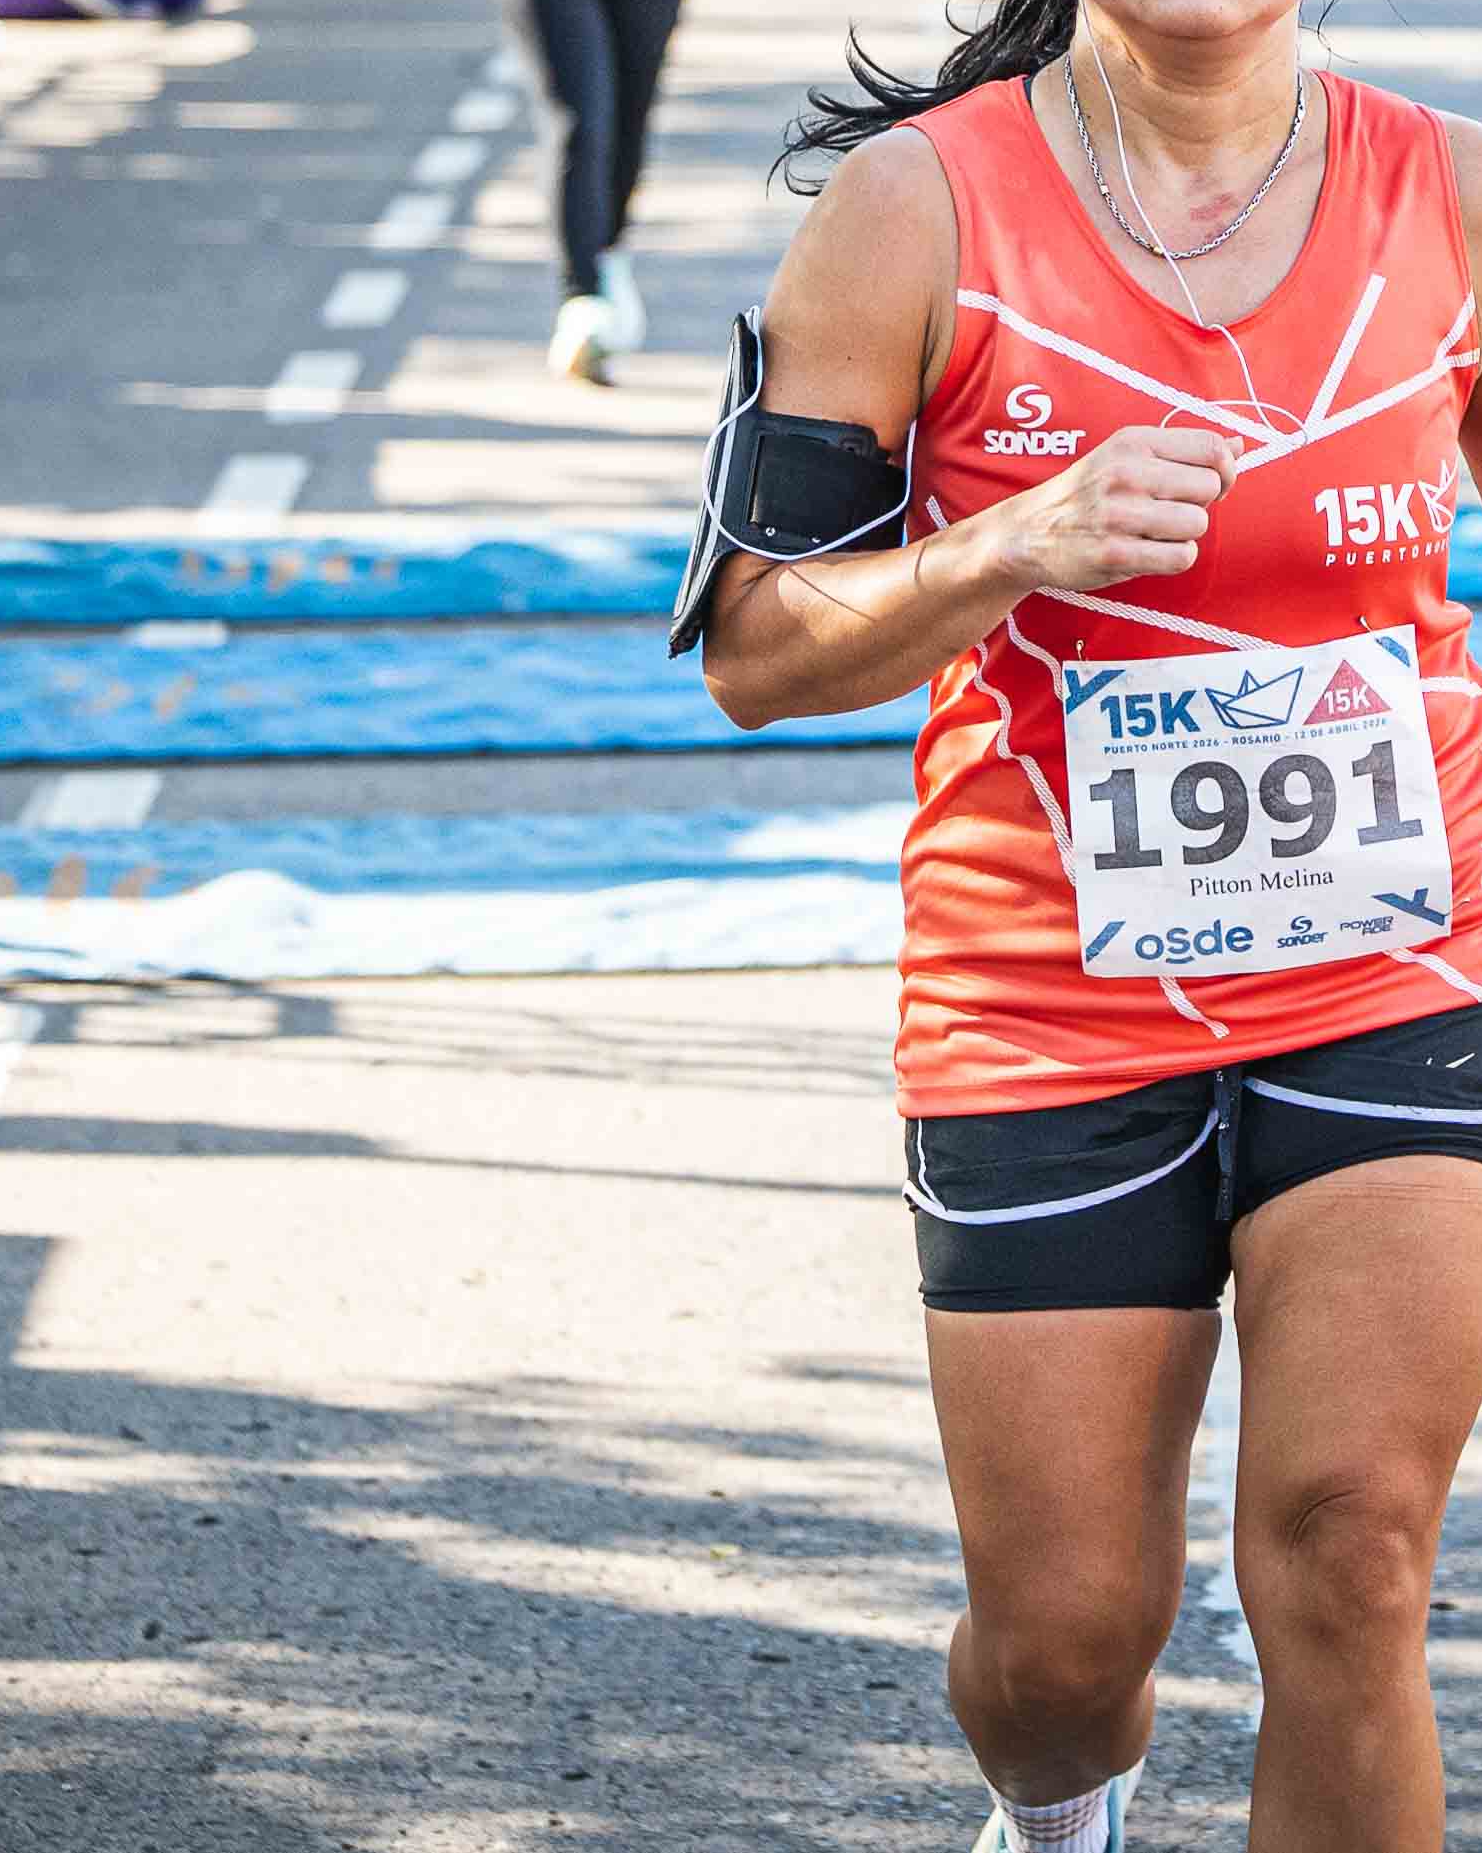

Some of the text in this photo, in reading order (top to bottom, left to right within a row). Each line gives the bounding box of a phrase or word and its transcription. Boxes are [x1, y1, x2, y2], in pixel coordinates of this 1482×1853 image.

[1315, 483, 1420, 546] 15K
[1325, 545, 1419, 566] PUERTO
[1100, 690, 1200, 739] 15K
[1323, 686, 1371, 714] 15K
[1103, 743, 1148, 755] PUERTO
[1151, 739, 1189, 751] NORTE
[1193, 737, 1219, 748] 2026
[1232, 733, 1281, 746] ROSARIO
[1294, 731, 1307, 740] 12
[1311, 729, 1324, 738] DE
[1327, 725, 1360, 736] ABRIL
[1089, 740, 1424, 871] 1991
[1190, 870, 1335, 897] Pitton Melina
[1134, 919, 1254, 964] osde
